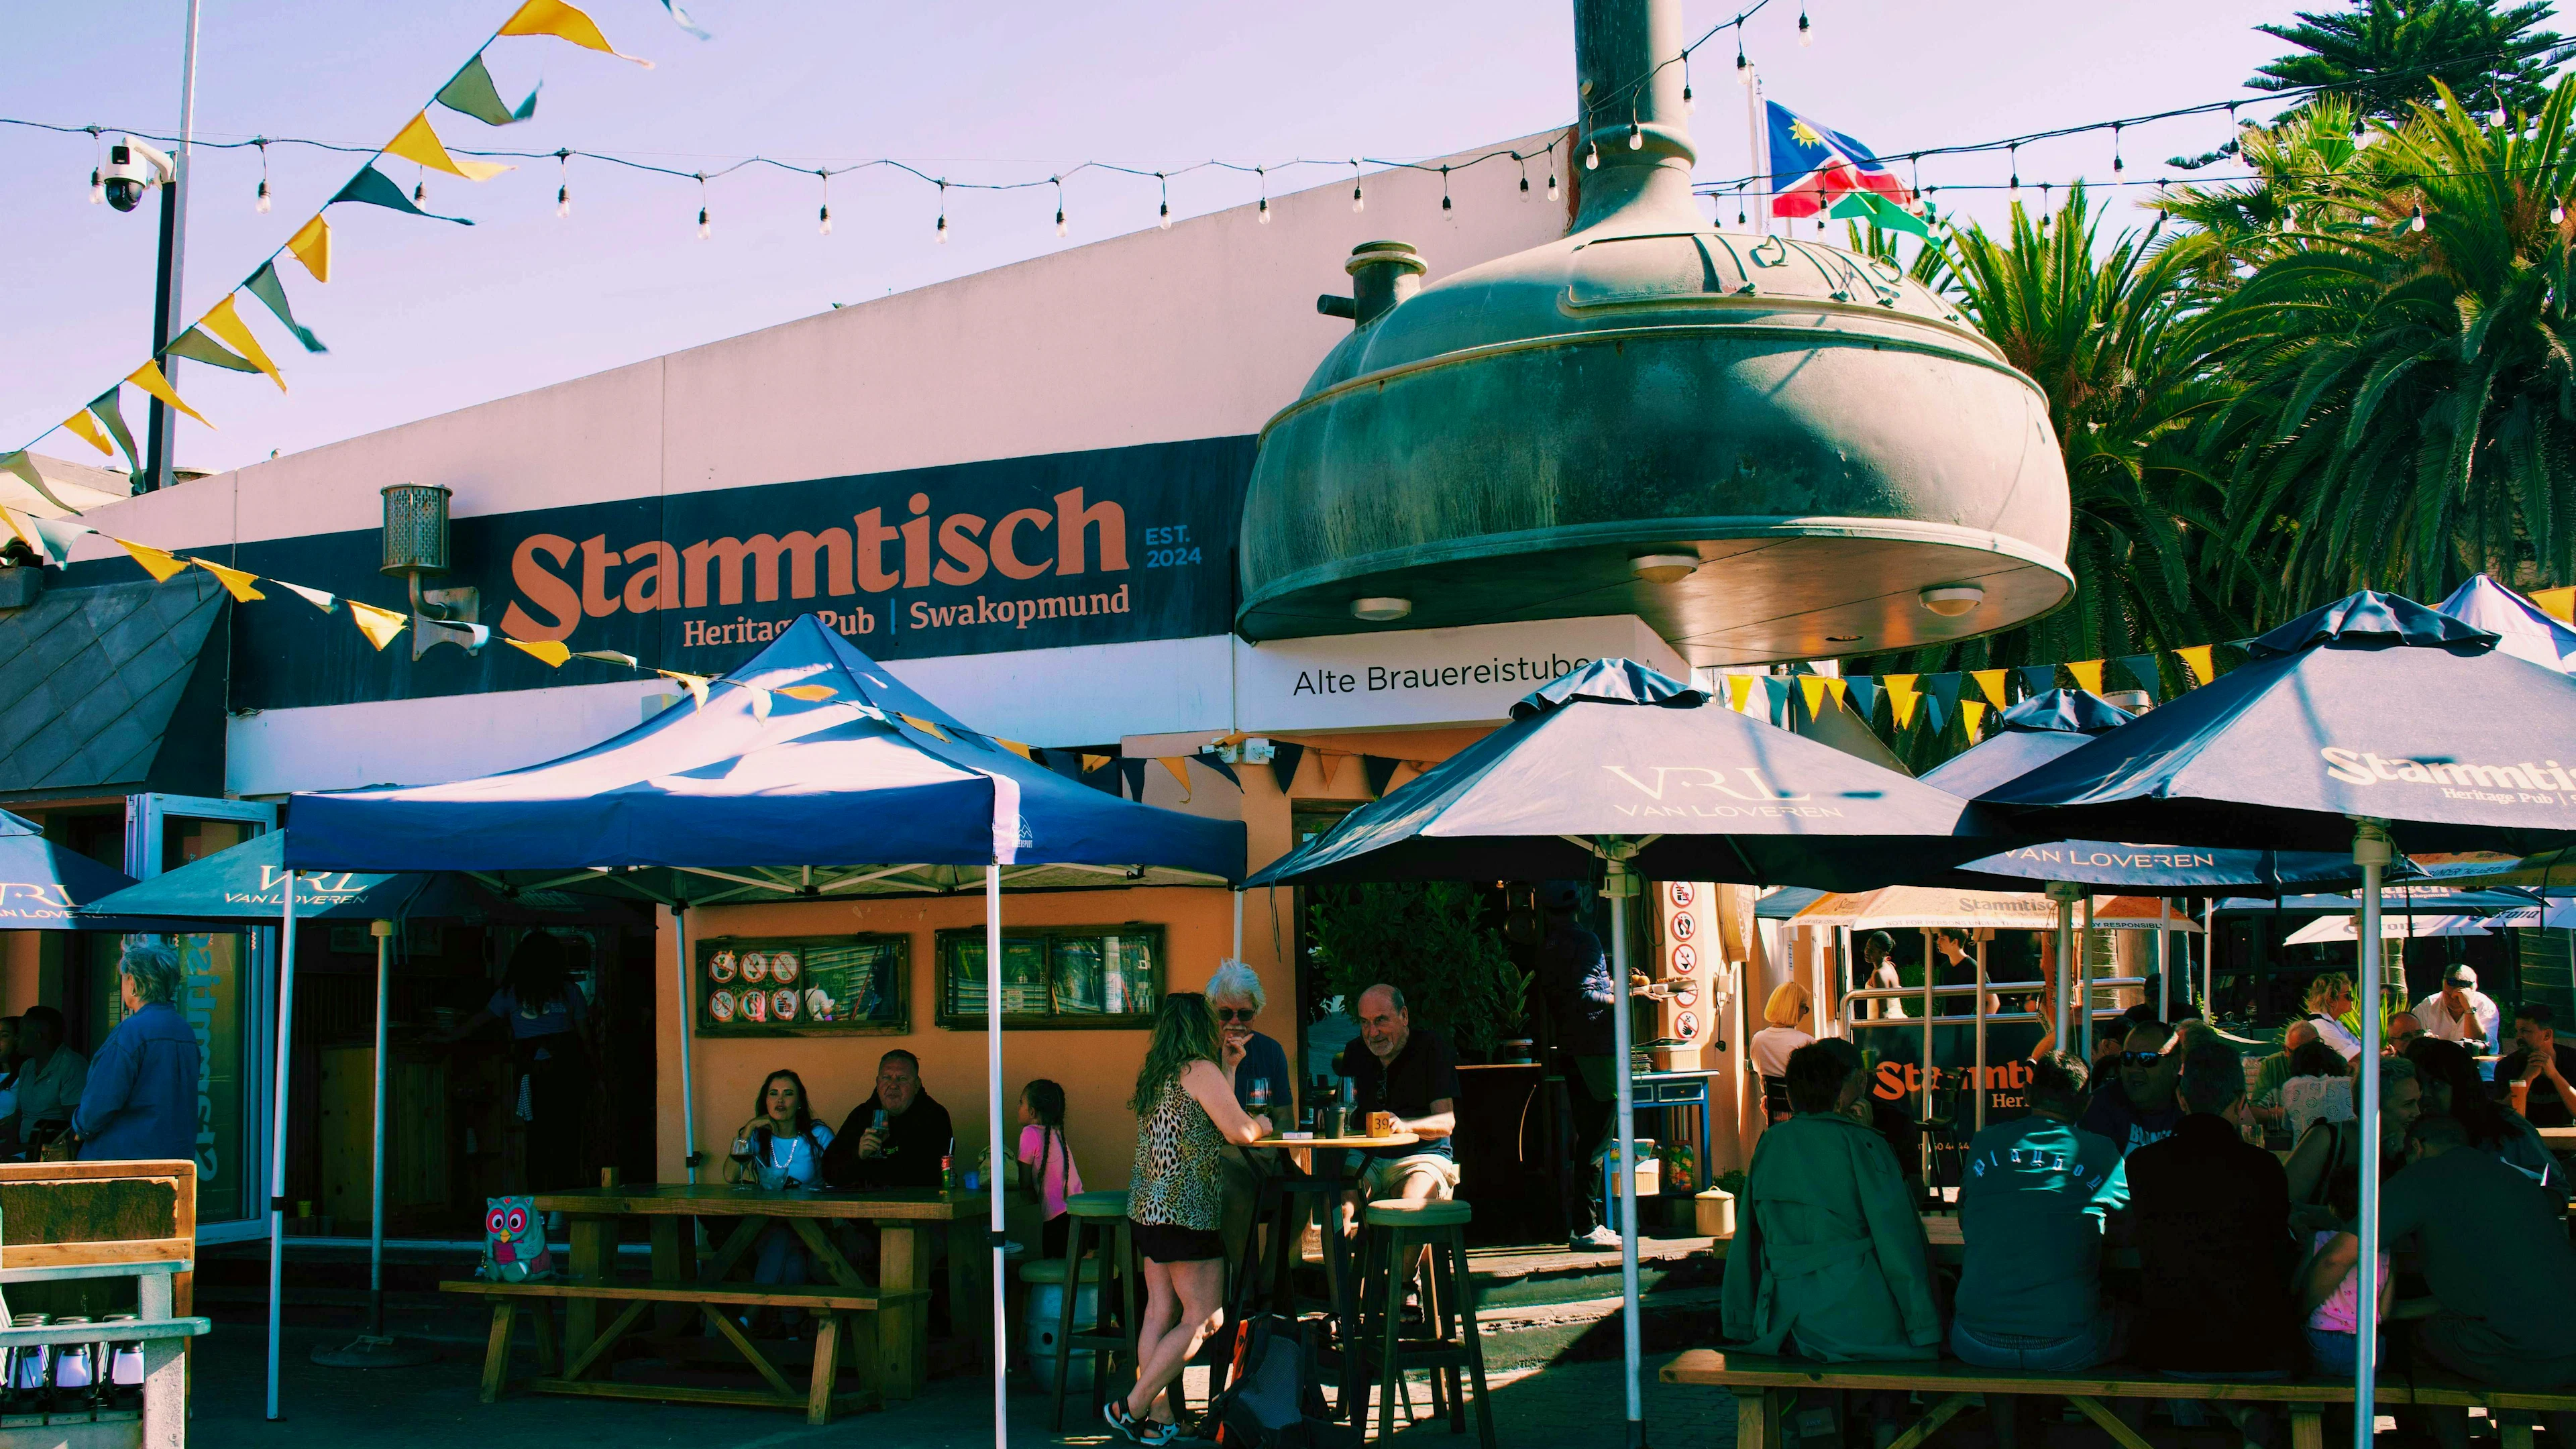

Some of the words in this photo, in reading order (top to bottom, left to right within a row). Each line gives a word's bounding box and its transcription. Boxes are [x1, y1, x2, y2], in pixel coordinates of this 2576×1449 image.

[1146, 525, 1191, 545] EST.
[499, 486, 1130, 643] Stammtisch
[1147, 547, 1202, 568] 2024
[684, 616, 793, 647] Heritag
[816, 606, 875, 636] Pub
[910, 585, 1130, 630] Swakopmund
[1293, 669, 1356, 696] Alte
[1601, 765, 1811, 801] VRL
[2440, 788, 2516, 804] Heritage
[2520, 792, 2554, 804] Pub
[1613, 804, 1687, 817] VAN
[1690, 804, 1844, 818] LOVEREN
[2070, 850, 2214, 868] LOVEREN
[225, 893, 268, 904] VAN
[1374, 1118, 1389, 1130] 39
